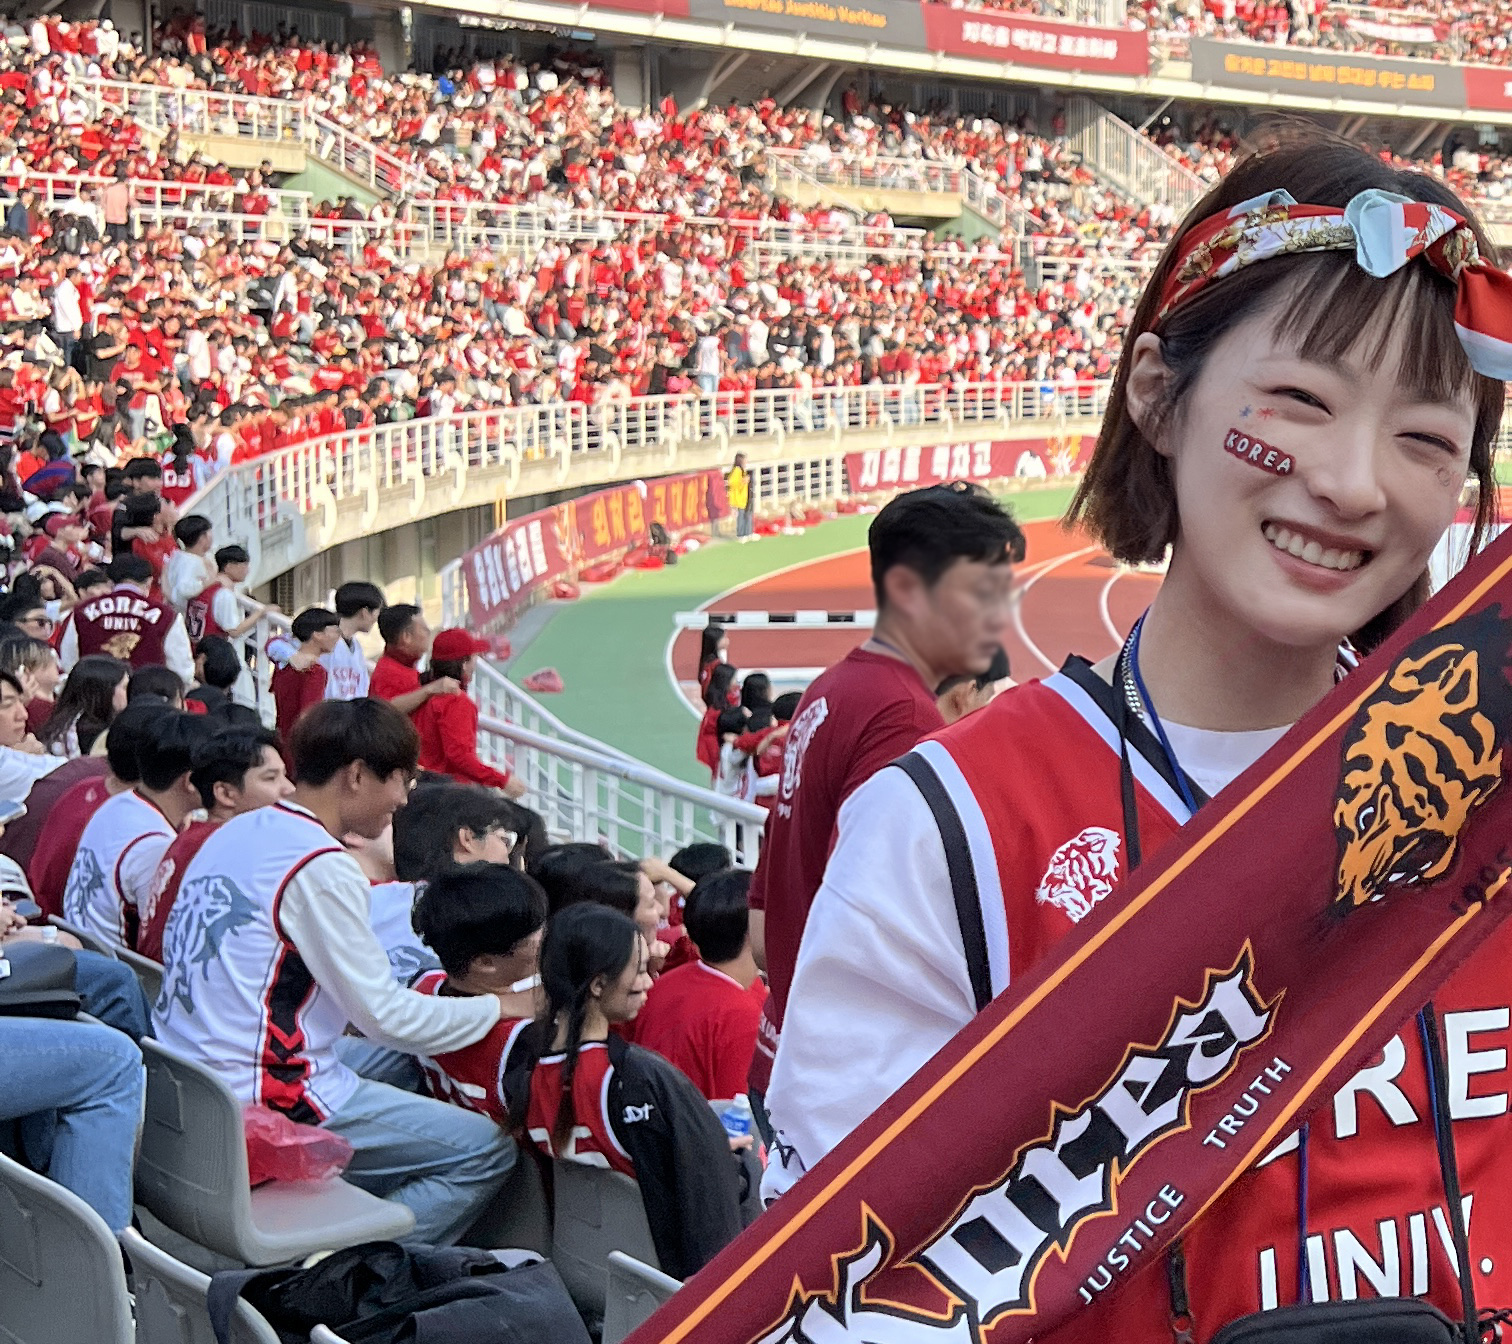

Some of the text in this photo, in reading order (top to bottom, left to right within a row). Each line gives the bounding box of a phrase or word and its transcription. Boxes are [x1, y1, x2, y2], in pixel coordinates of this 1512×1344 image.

[1225, 430, 1294, 476] KOREA
[83, 595, 162, 625] KOREA
[102, 615, 142, 632] UNIV.
[1078, 1056, 1293, 1306] JUSTICE TRUTH
[1258, 1194, 1495, 1311] UNIV.
